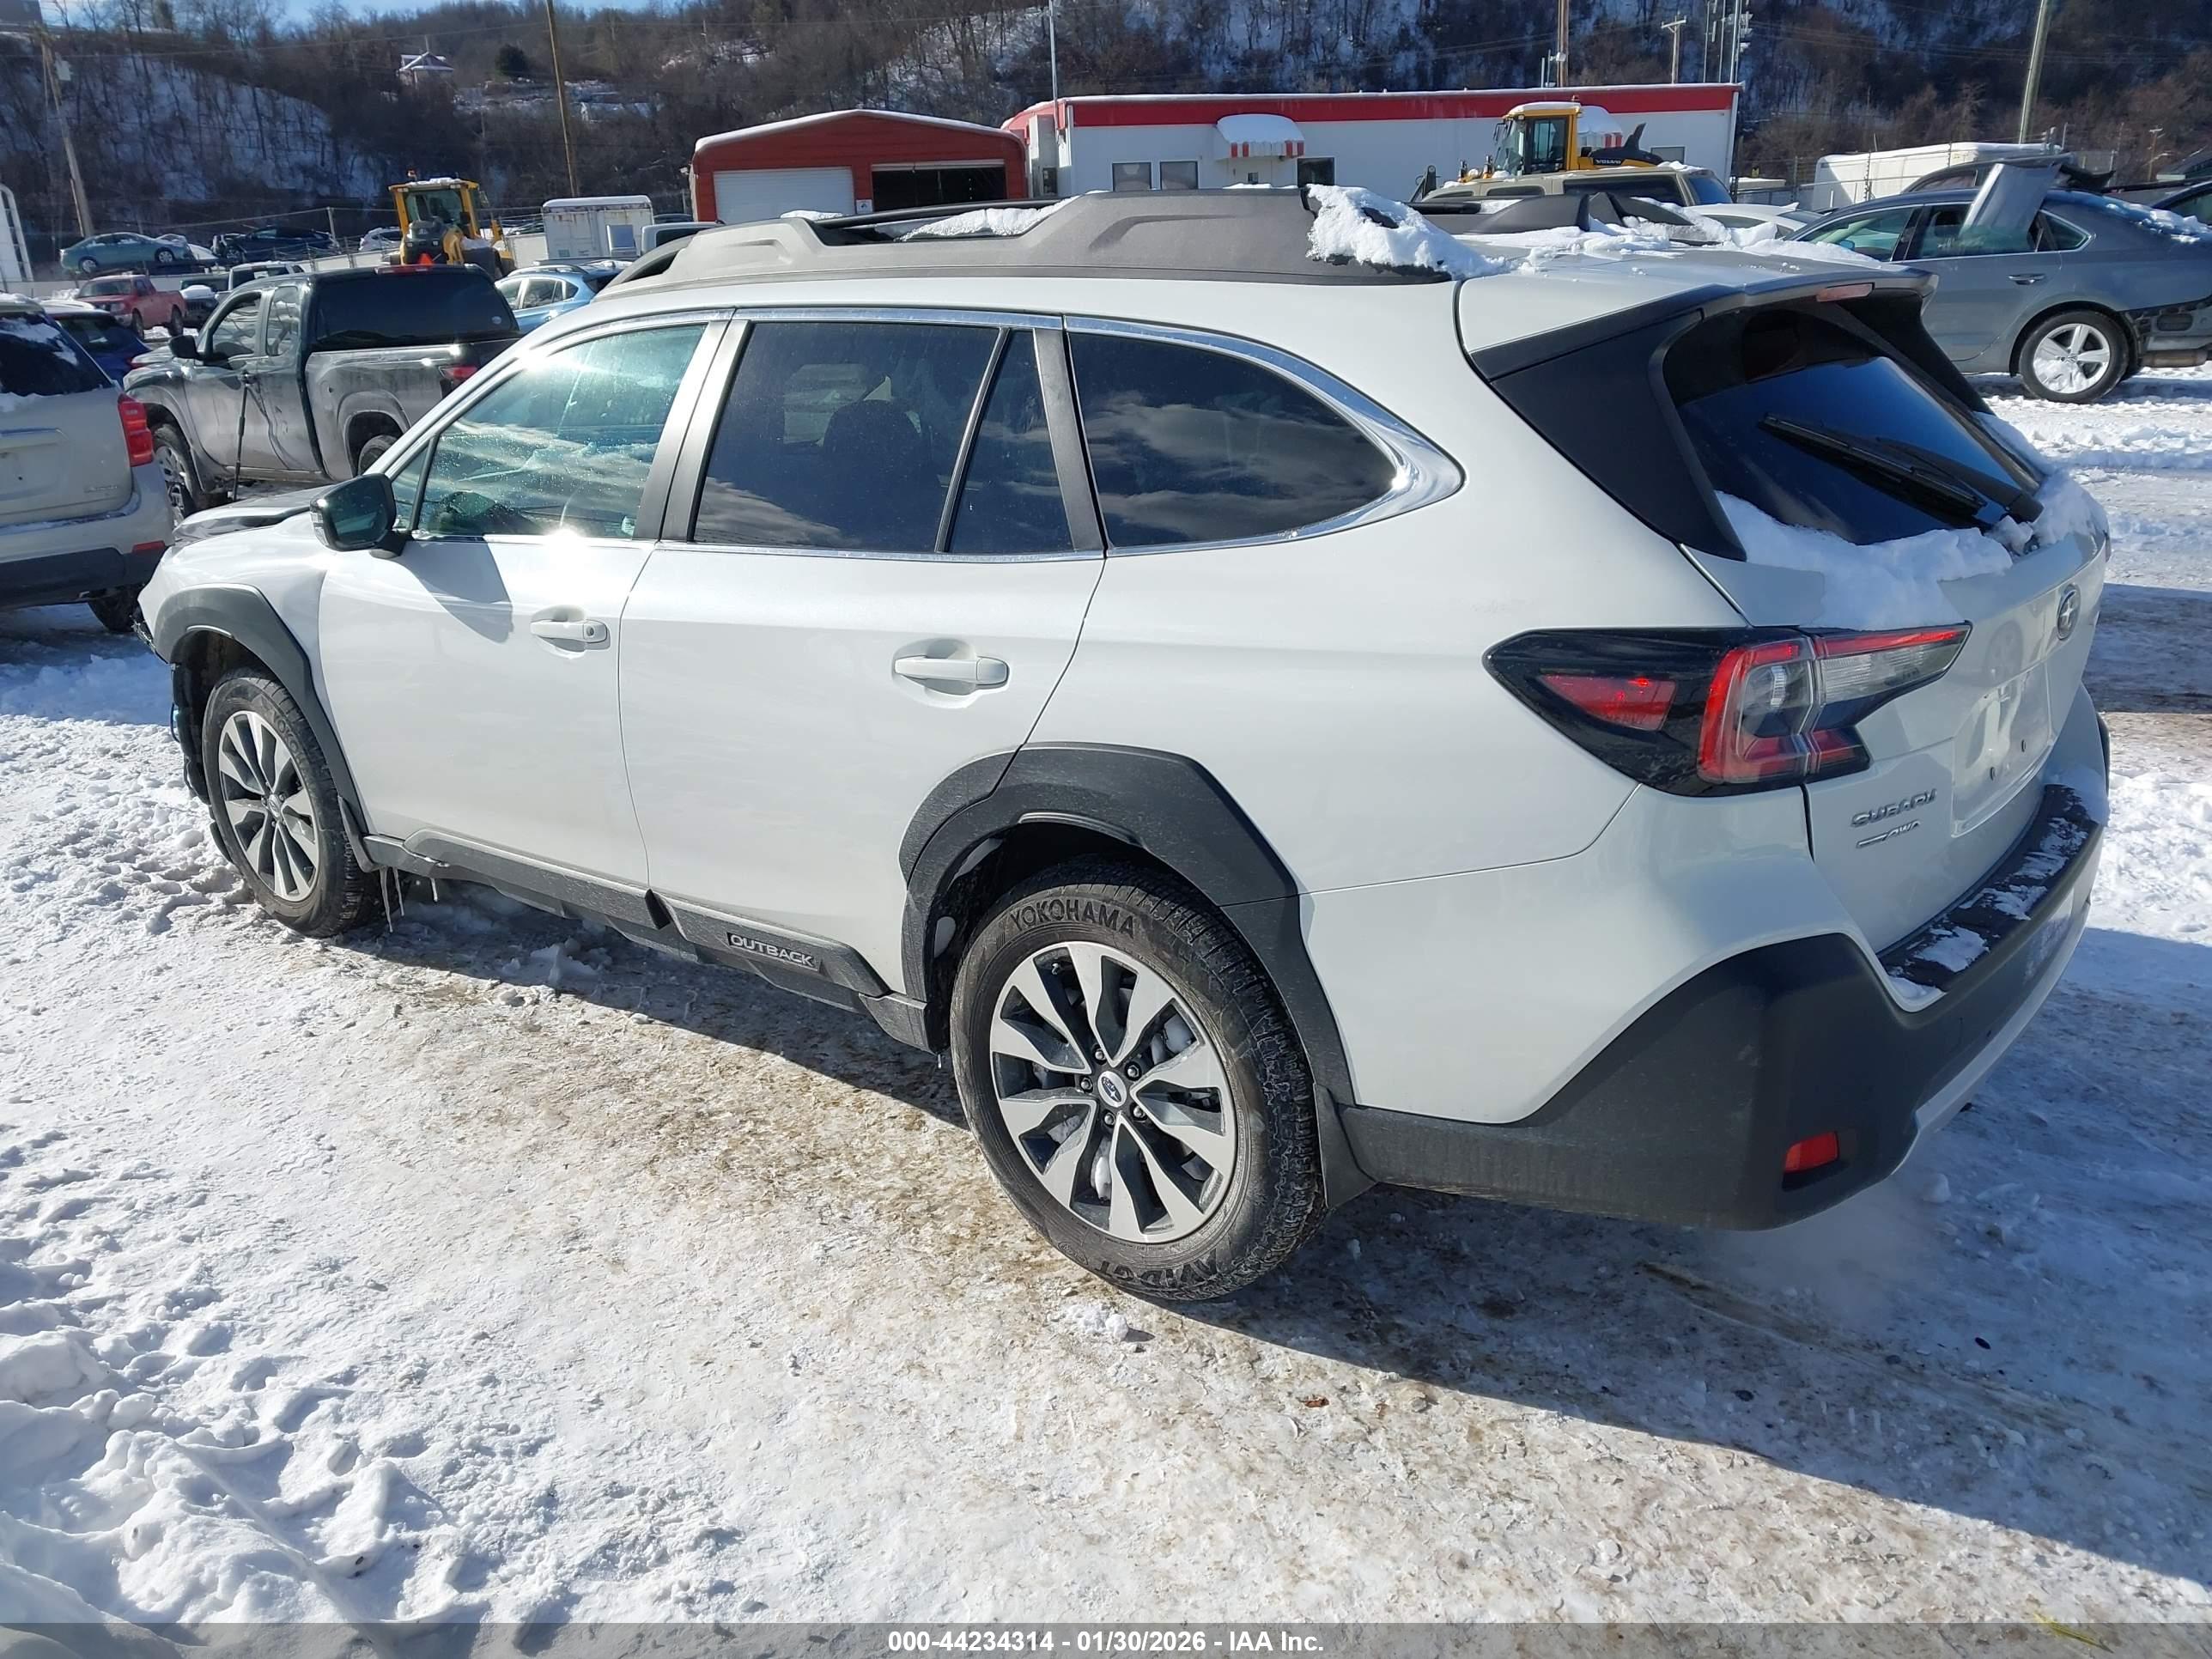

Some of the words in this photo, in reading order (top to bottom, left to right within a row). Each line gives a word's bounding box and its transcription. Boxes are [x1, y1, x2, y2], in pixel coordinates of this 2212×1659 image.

[1850, 787, 1937, 827] SUBARU
[1010, 897, 1134, 940] YOKOHAMA
[730, 933, 814, 968] OUTBACK
